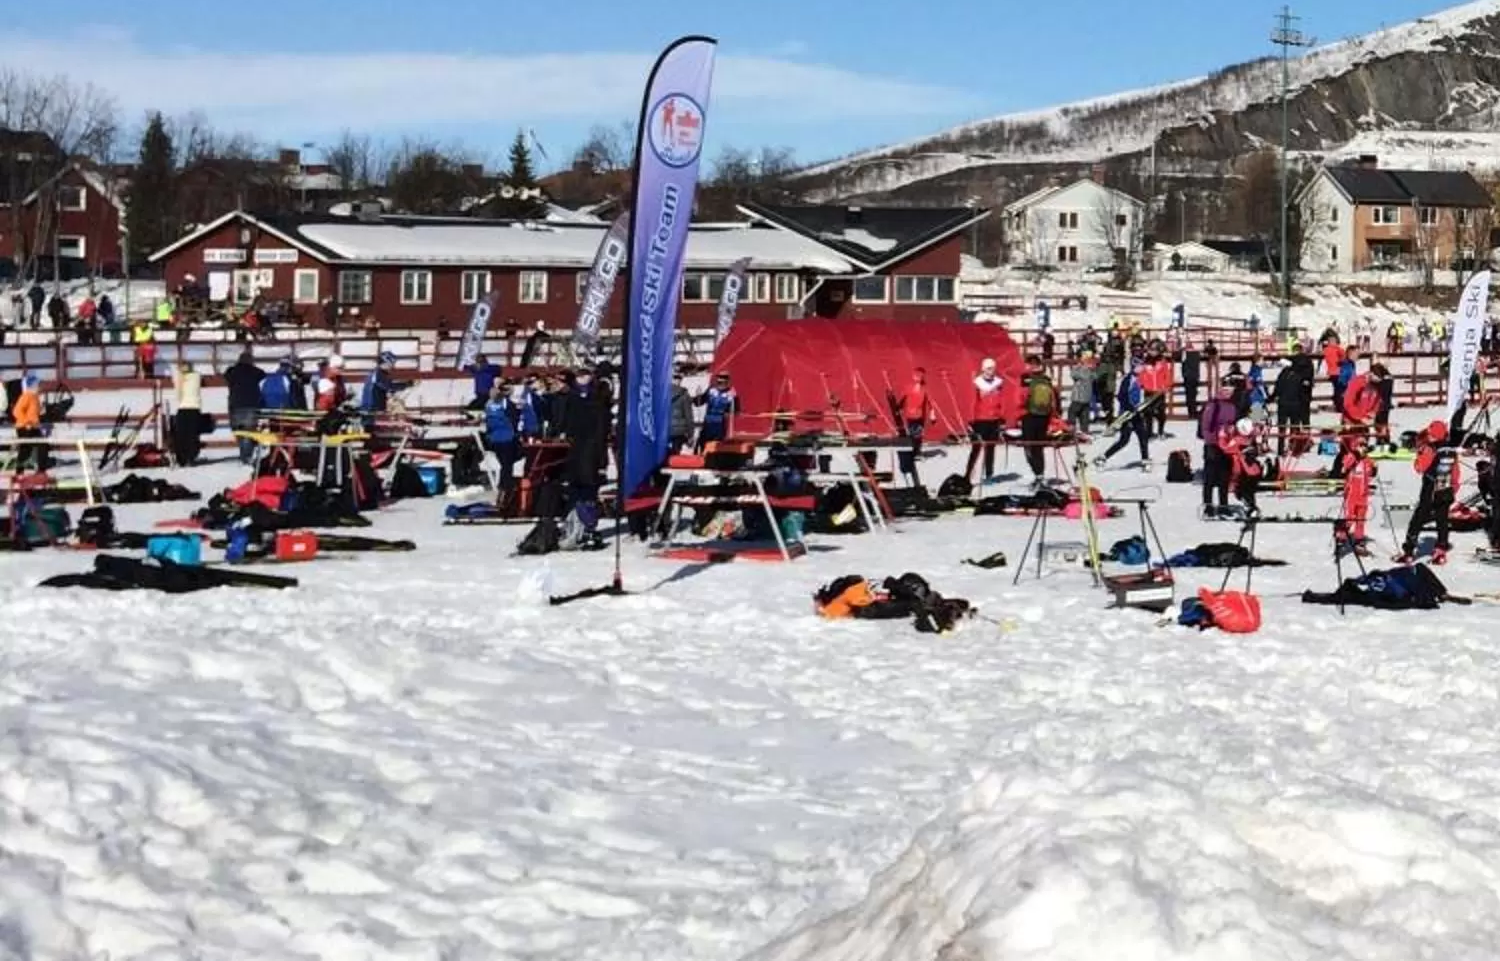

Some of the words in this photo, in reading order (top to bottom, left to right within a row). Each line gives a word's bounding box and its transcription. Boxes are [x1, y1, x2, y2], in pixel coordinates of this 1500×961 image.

[650, 184, 680, 259] Team
[642, 262, 662, 314] Ski
[1466, 285, 1480, 318] Ski
[1460, 328, 1476, 393] Senja
